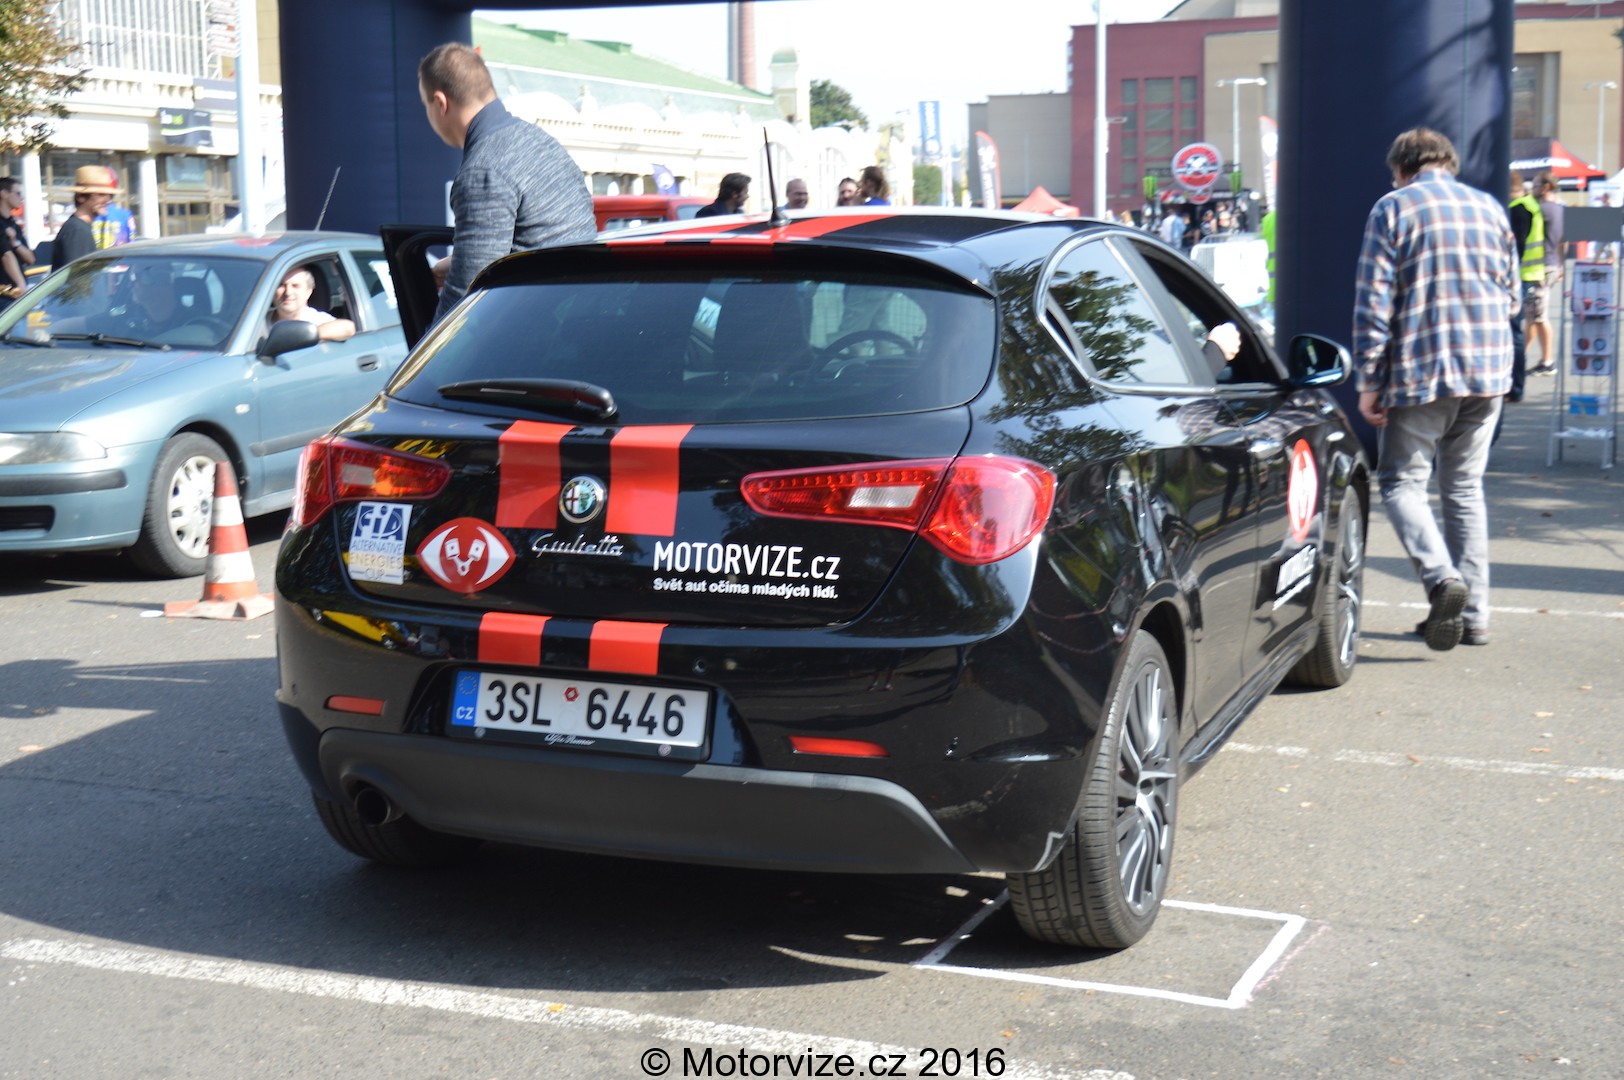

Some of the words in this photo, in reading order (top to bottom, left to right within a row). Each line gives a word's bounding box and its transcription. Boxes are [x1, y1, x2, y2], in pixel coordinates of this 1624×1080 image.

[351, 539, 404, 555] ALTERNATIVE
[531, 533, 624, 558] Giulietta
[350, 552, 403, 570] ENERGIES
[365, 568, 385, 581] CUP
[653, 577, 683, 592] Svět
[684, 579, 707, 593] aut
[709, 580, 750, 595] očima
[752, 583, 810, 599] mladých
[812, 585, 839, 600] lidí.
[456, 706, 475, 721] CZ
[485, 680, 551, 726] 3SL
[586, 688, 687, 737] 6446
